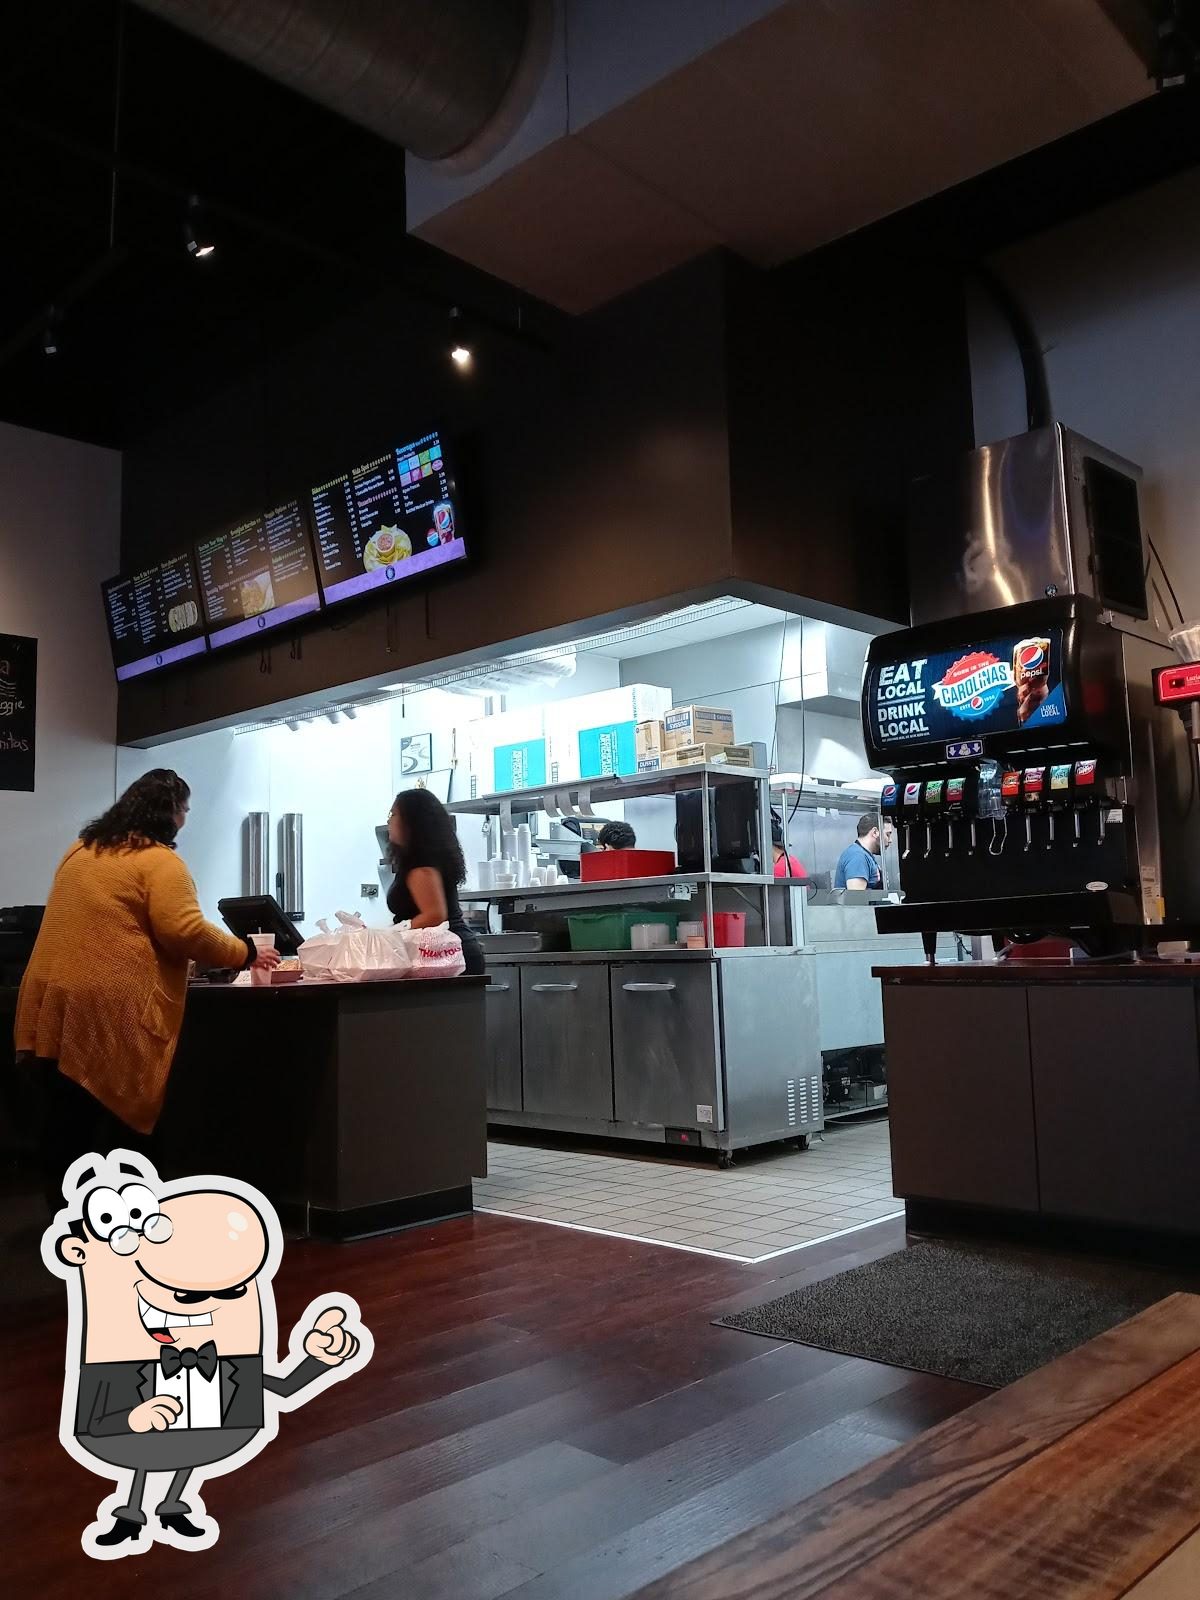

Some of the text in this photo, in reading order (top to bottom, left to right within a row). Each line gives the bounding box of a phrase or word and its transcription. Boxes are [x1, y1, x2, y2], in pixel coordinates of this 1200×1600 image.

[879, 658, 928, 686] EAT
[877, 681, 926, 700] LOCAL
[941, 664, 1008, 704] CAROLINAS
[877, 701, 926, 722] DRINK
[1041, 706, 1061, 718] LOCAL
[880, 718, 929, 738] LOCAL
